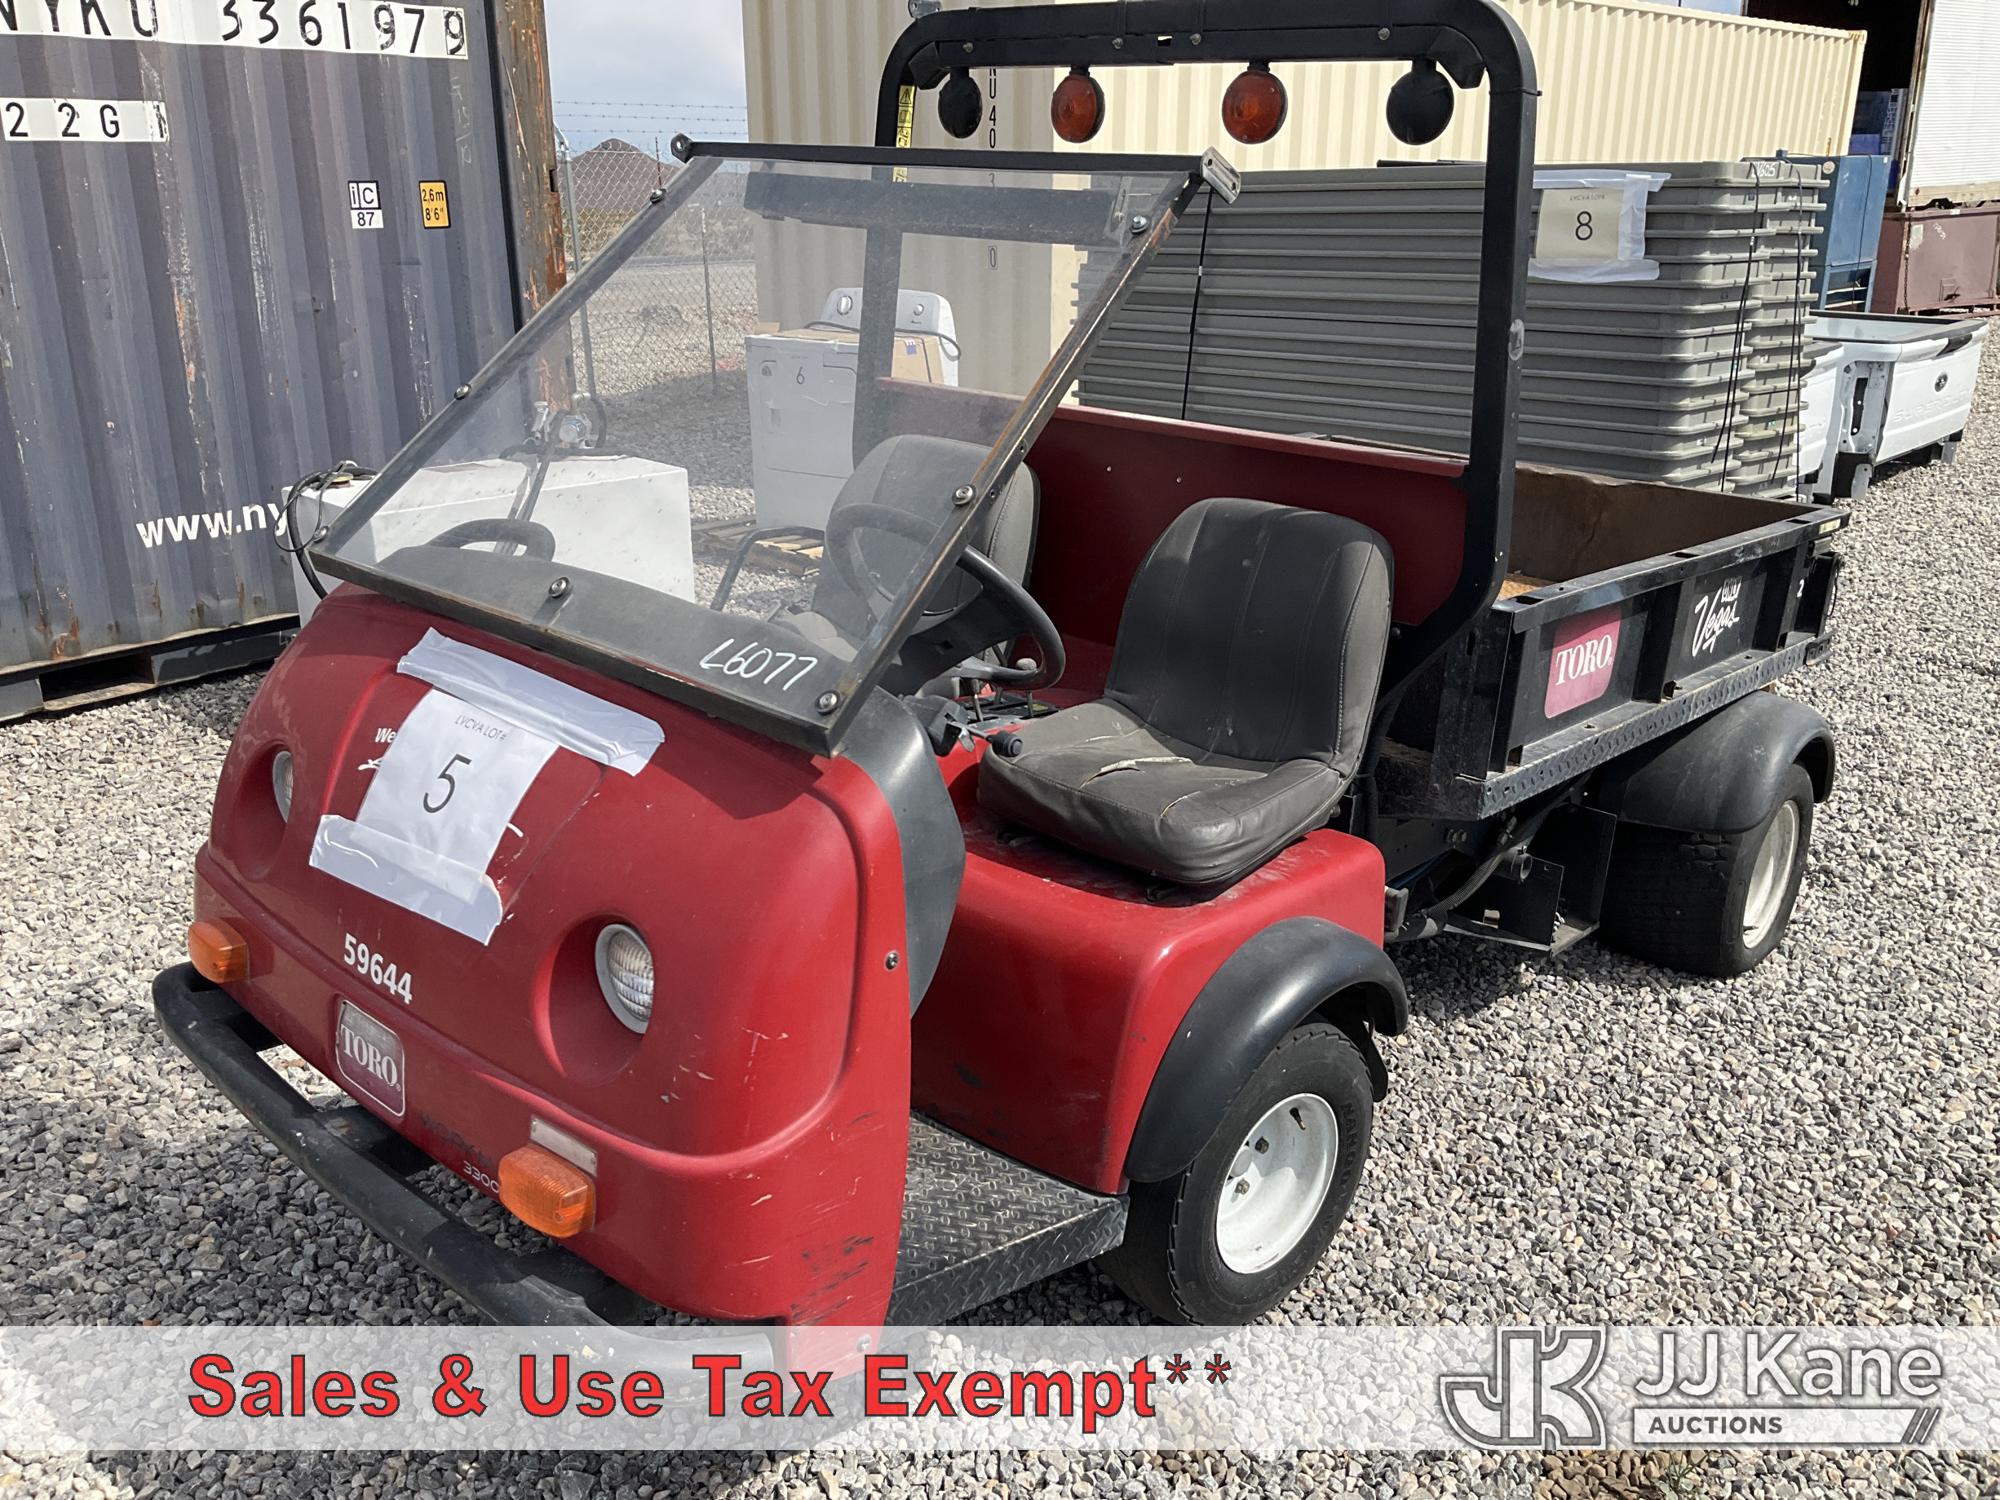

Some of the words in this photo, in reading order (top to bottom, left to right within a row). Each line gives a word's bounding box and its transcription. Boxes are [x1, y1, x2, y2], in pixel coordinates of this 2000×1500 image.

[357, 211, 375, 227] 87
[1575, 211, 1593, 240] 8
[796, 366, 805, 385] 6
[699, 638, 818, 691] L6077
[1555, 634, 1613, 686] TORO
[423, 753, 473, 814] 5
[343, 932, 413, 1005] 59644
[340, 1023, 399, 1089] TORO
